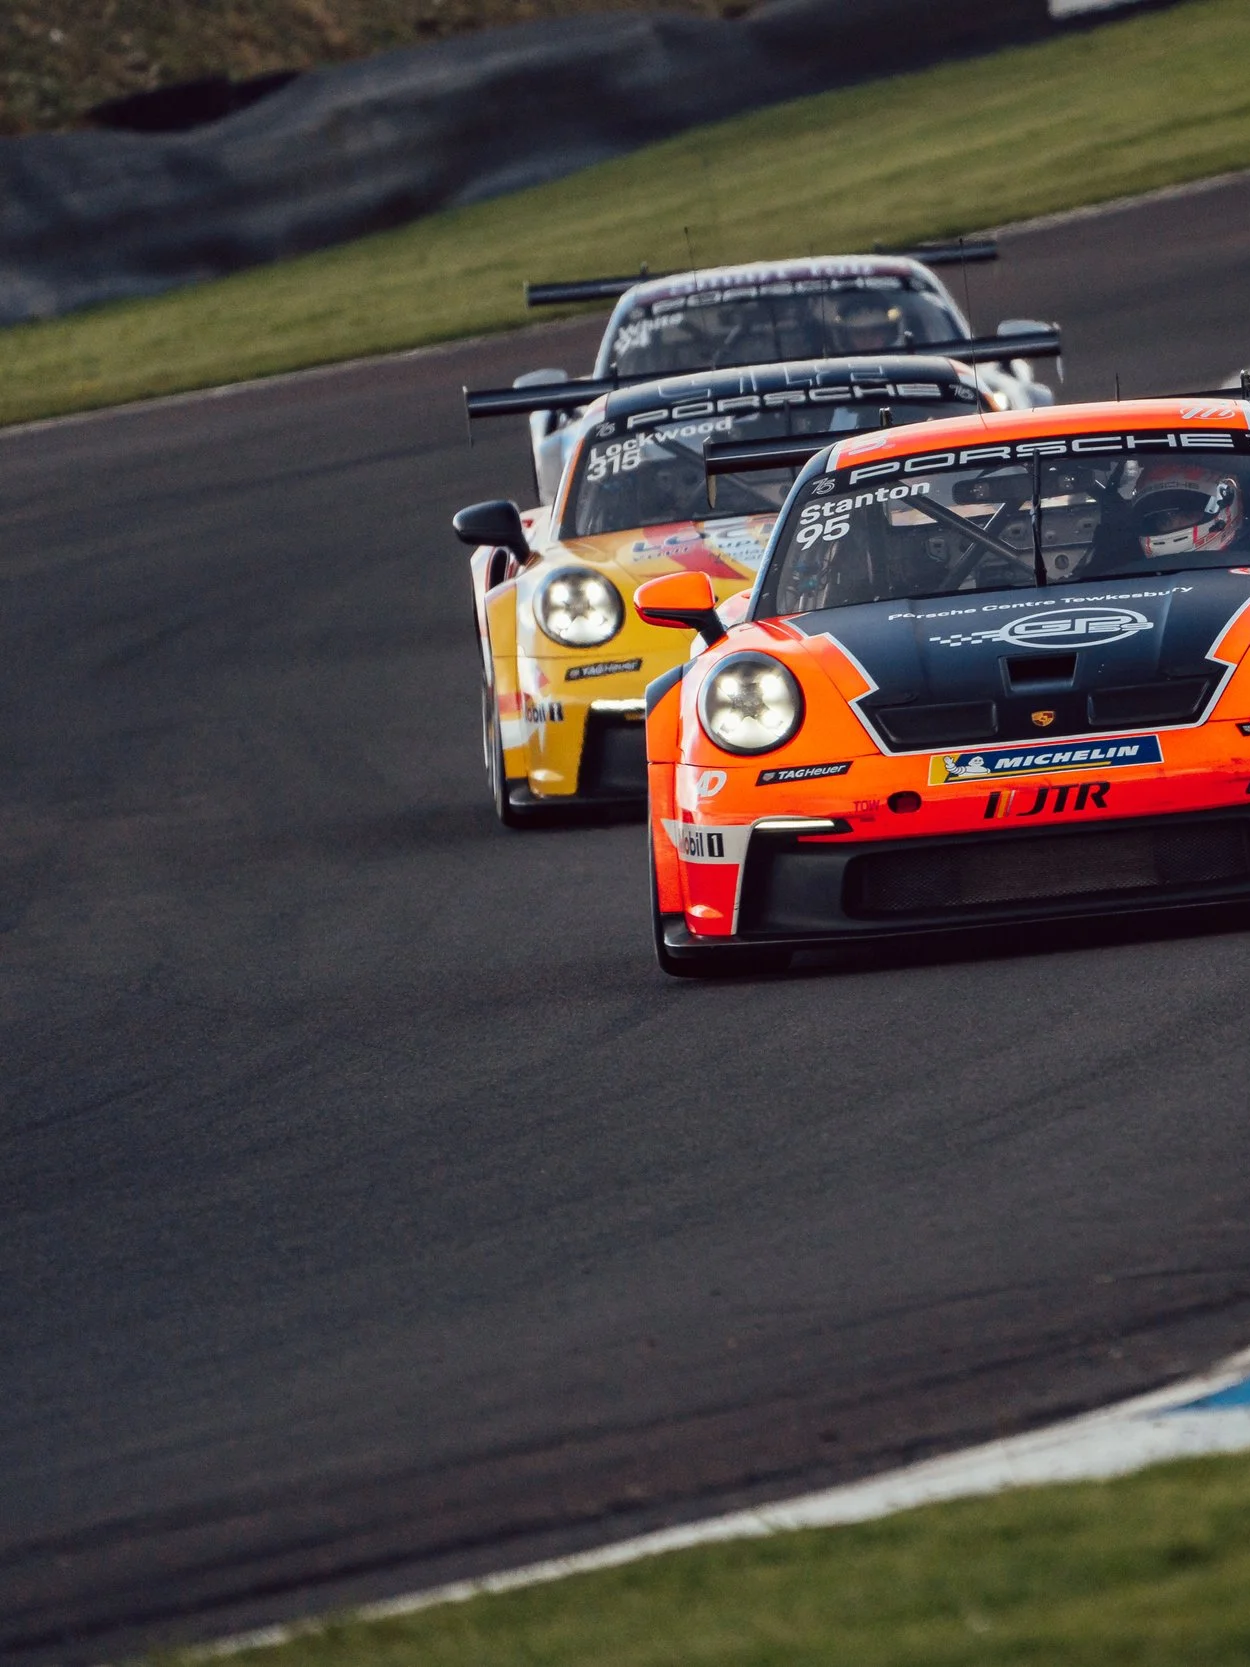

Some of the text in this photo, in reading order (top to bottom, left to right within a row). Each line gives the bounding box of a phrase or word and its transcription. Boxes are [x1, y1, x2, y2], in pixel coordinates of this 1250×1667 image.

[626, 382, 942, 429] PORSCHE
[590, 415, 735, 465] Lockwood
[586, 449, 641, 482] 315
[849, 433, 1235, 485] PORSCHE
[800, 482, 931, 525] Stanton
[796, 514, 850, 551] 95
[888, 586, 1194, 621] Porsche Centre Tewkesbury
[993, 744, 1140, 770] MICHELIN
[1016, 781, 1111, 817] JTR
